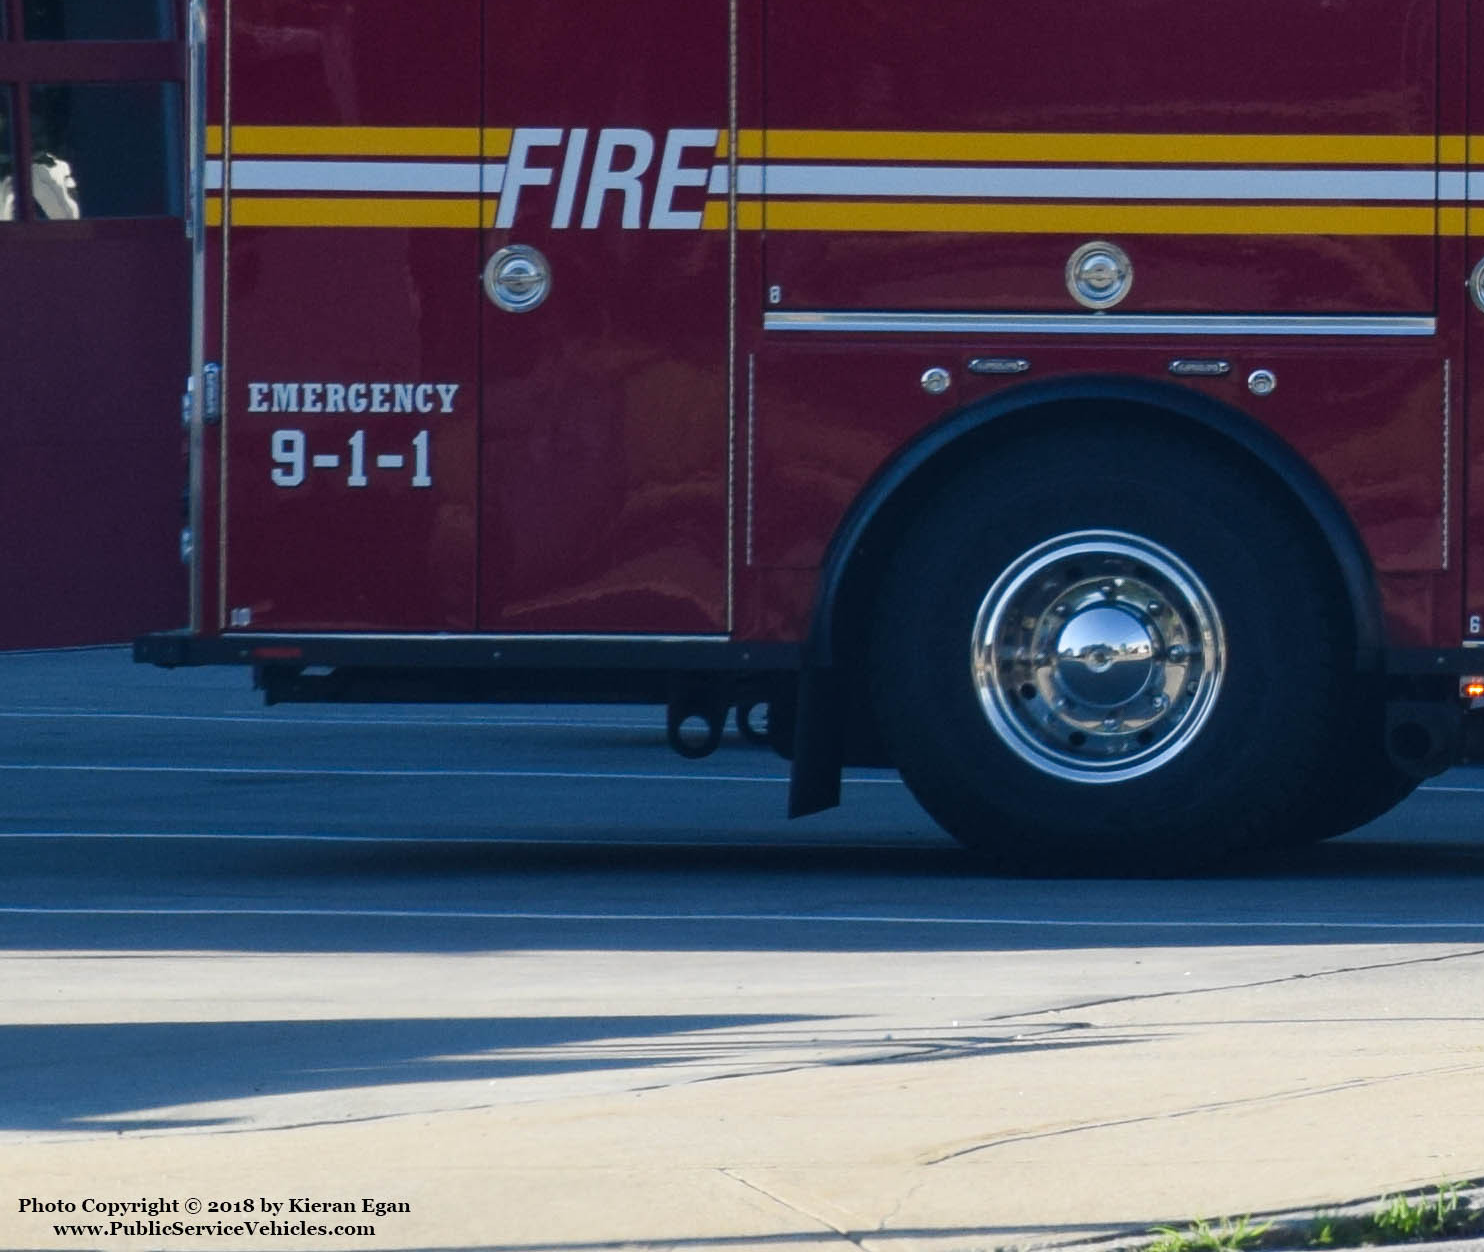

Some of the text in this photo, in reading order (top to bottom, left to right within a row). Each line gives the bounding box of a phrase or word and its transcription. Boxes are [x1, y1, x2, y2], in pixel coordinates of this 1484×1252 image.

[495, 129, 718, 230] FIRE
[248, 383, 459, 413] EMERGENCY
[271, 430, 433, 487] 9-1-1
[1470, 615, 1480, 633] 6
